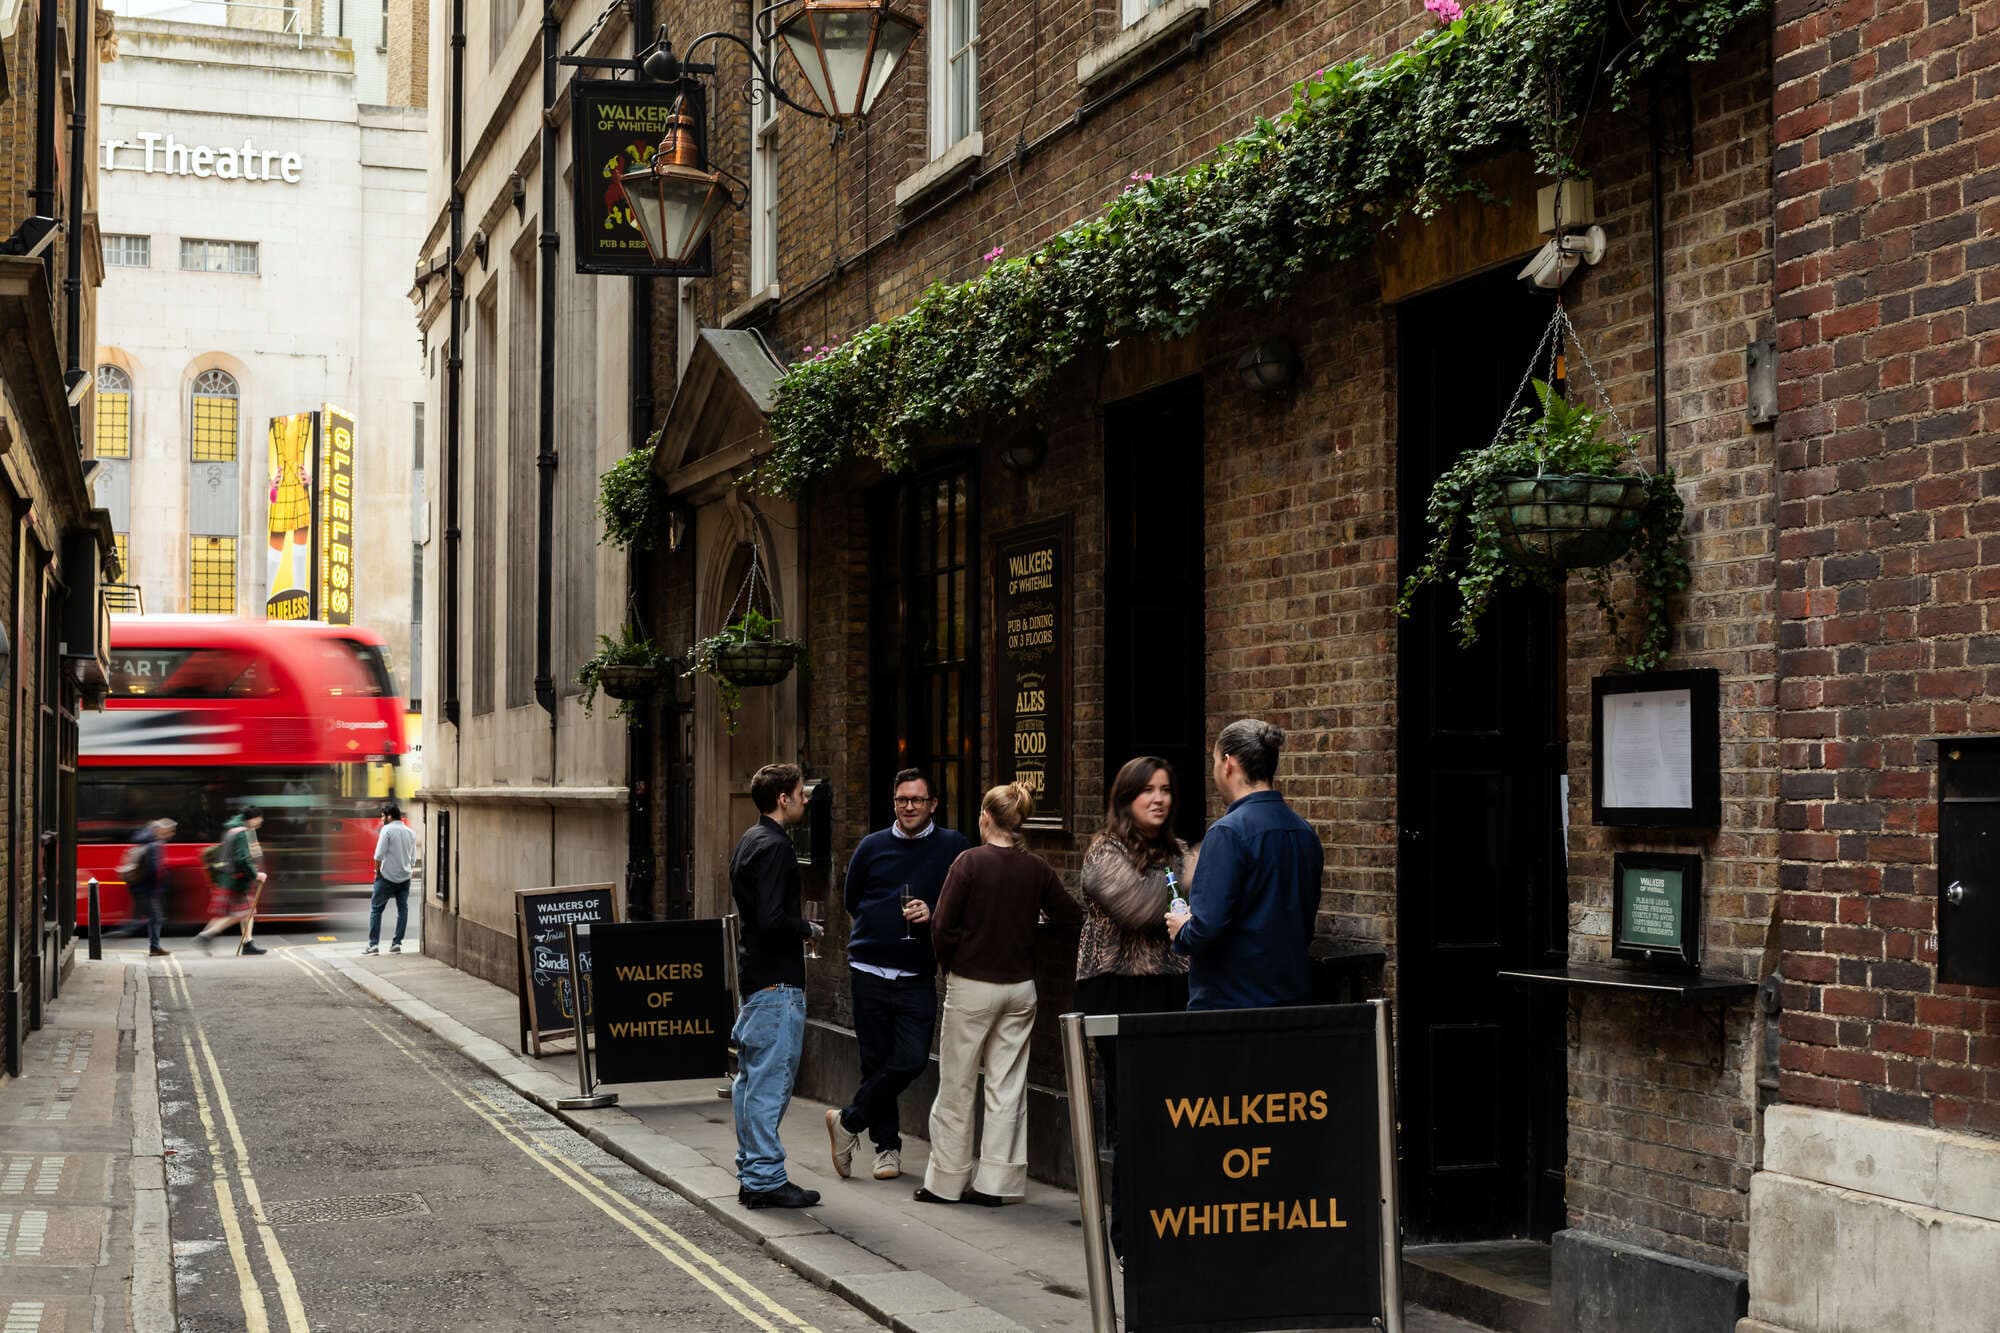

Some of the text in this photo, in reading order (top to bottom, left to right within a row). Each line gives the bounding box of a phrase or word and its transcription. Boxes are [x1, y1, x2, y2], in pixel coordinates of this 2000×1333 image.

[597, 104, 668, 121] WALKER
[598, 120, 667, 133] OF WHITEH
[105, 131, 304, 184] r Theatre
[600, 239, 647, 249] PUB & RES
[331, 426, 352, 614] CLUELESS
[1009, 548, 1053, 578] WALKERS
[1009, 573, 1053, 595] OF WHITEHALL
[267, 595, 309, 621] CLUELESS
[1008, 613, 1054, 633] PUB & DINING
[1008, 630, 1053, 649] ON 3 FLOORS
[1016, 690, 1045, 713] ALES
[1014, 732, 1047, 755] FOOD
[1640, 877, 1664, 888] WALKERS
[537, 899, 600, 913] WALKERS OF
[538, 911, 601, 925] WHITEHALL
[538, 952, 569, 970] Sunda
[615, 963, 704, 982] WALKERS
[647, 992, 674, 1009] OF
[608, 1018, 715, 1038] WHITEHALL
[1165, 1089, 1328, 1129] WALKERS
[1222, 1147, 1272, 1179] OF
[1149, 1197, 1348, 1240] WHITEHALL
